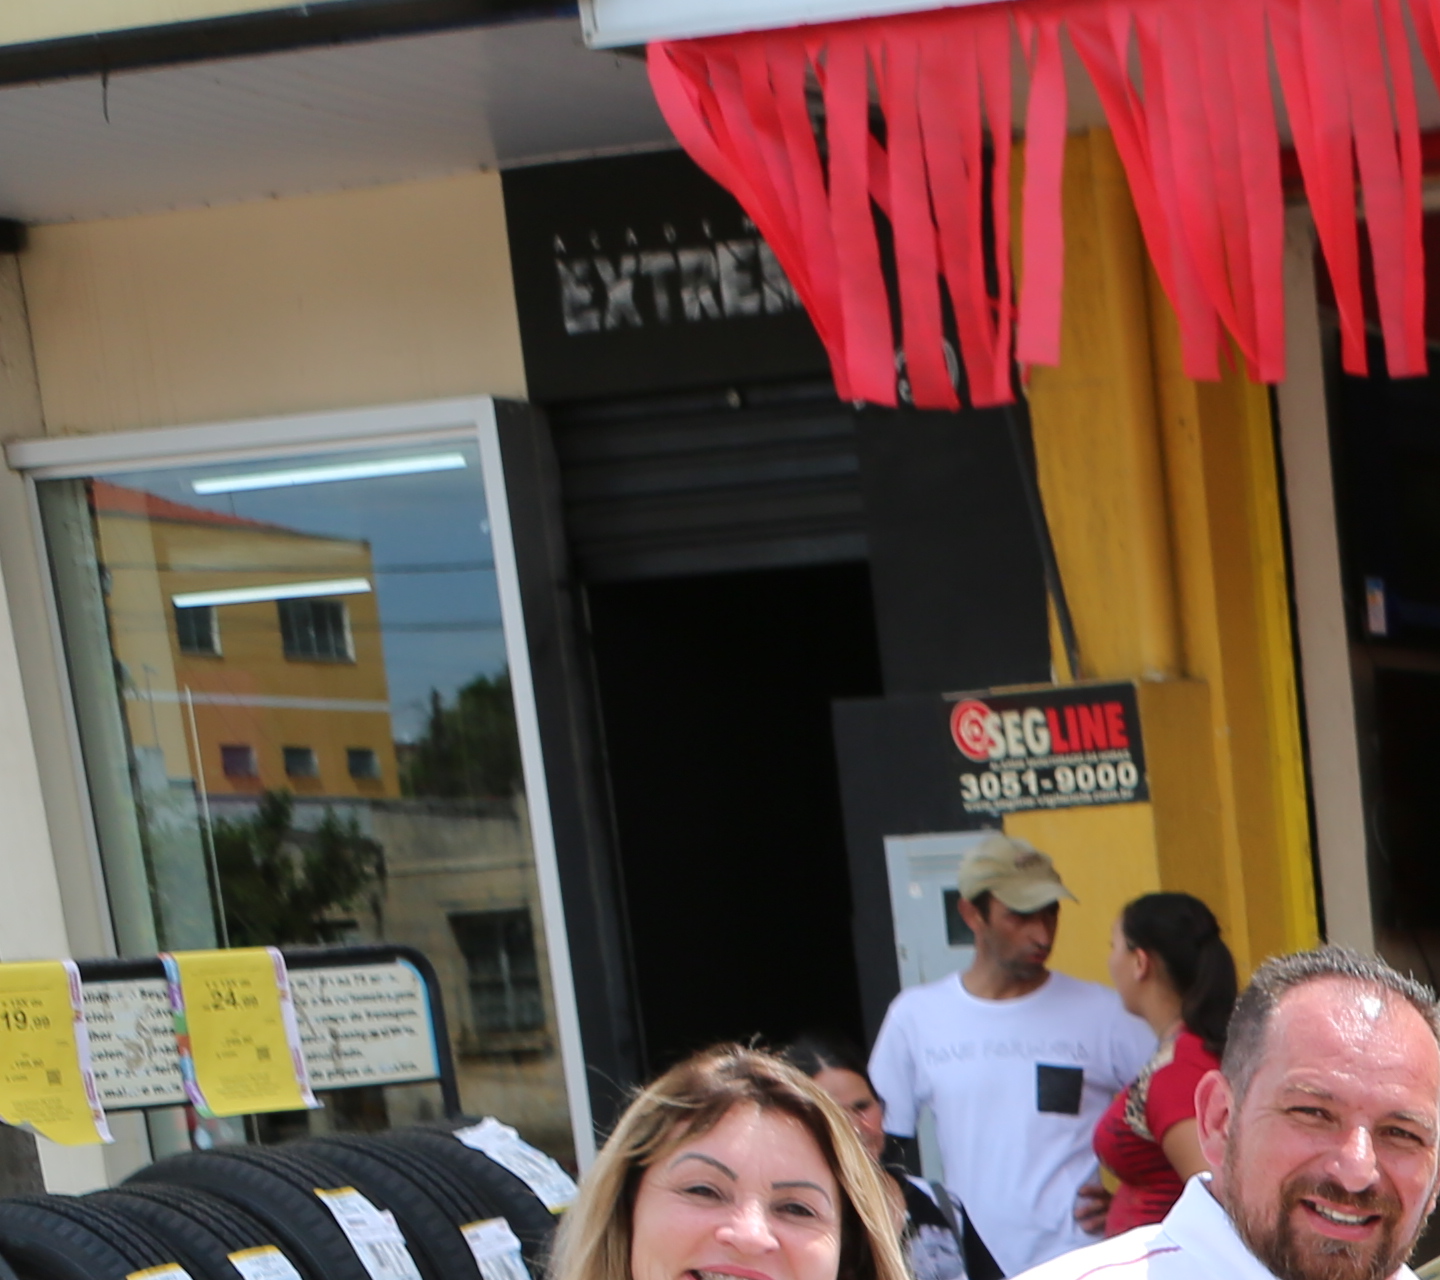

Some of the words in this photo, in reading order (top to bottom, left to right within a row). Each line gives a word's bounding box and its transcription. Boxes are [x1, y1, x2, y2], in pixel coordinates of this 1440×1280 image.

[556, 240, 802, 336] EXTREM
[984, 702, 1131, 761] SEGLINE
[959, 761, 1139, 803] 3051-9000
